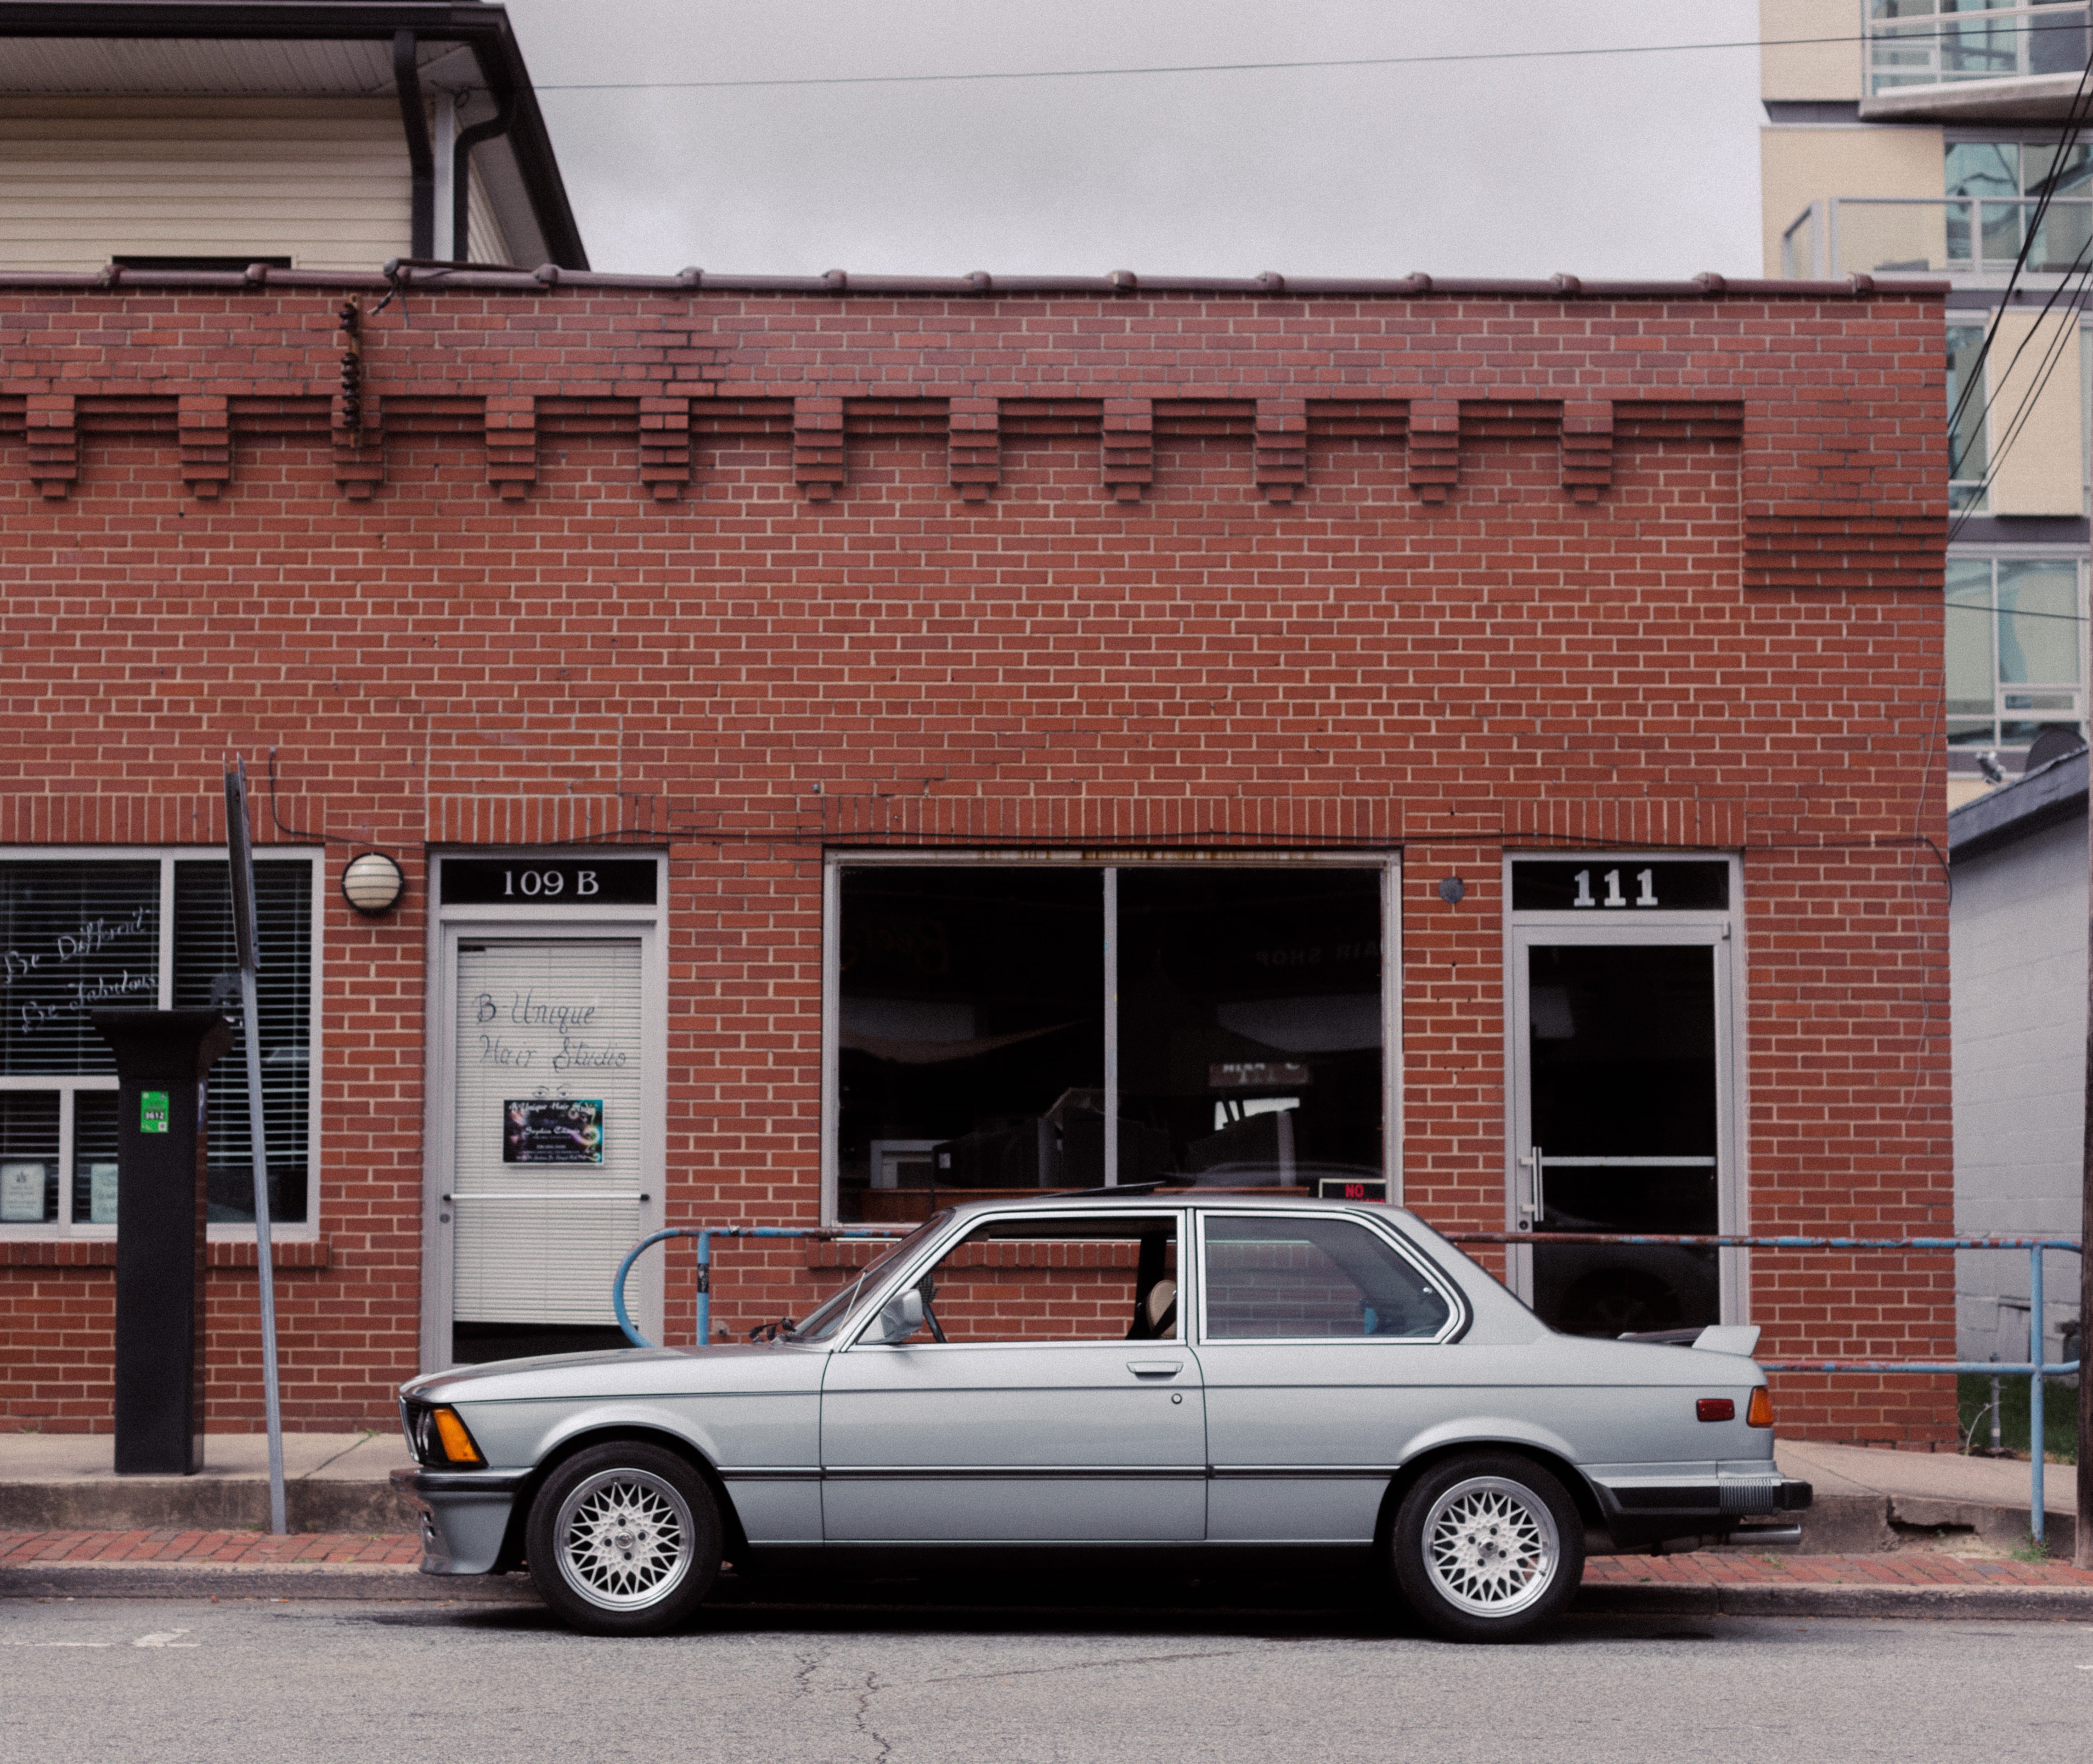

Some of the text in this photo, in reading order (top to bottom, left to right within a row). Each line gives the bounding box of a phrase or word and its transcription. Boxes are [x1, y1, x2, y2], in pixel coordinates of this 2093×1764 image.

[503, 870, 600, 896] 109 B
[1574, 868, 1659, 907] 111
[4, 906, 151, 984] Be Different
[21, 1000, 58, 1033] Be
[476, 988, 596, 1034] B Unique
[479, 1034, 627, 1074] Hair Studio
[549, 1101, 569, 1110] Hair
[1345, 1183, 1365, 1198] NO
